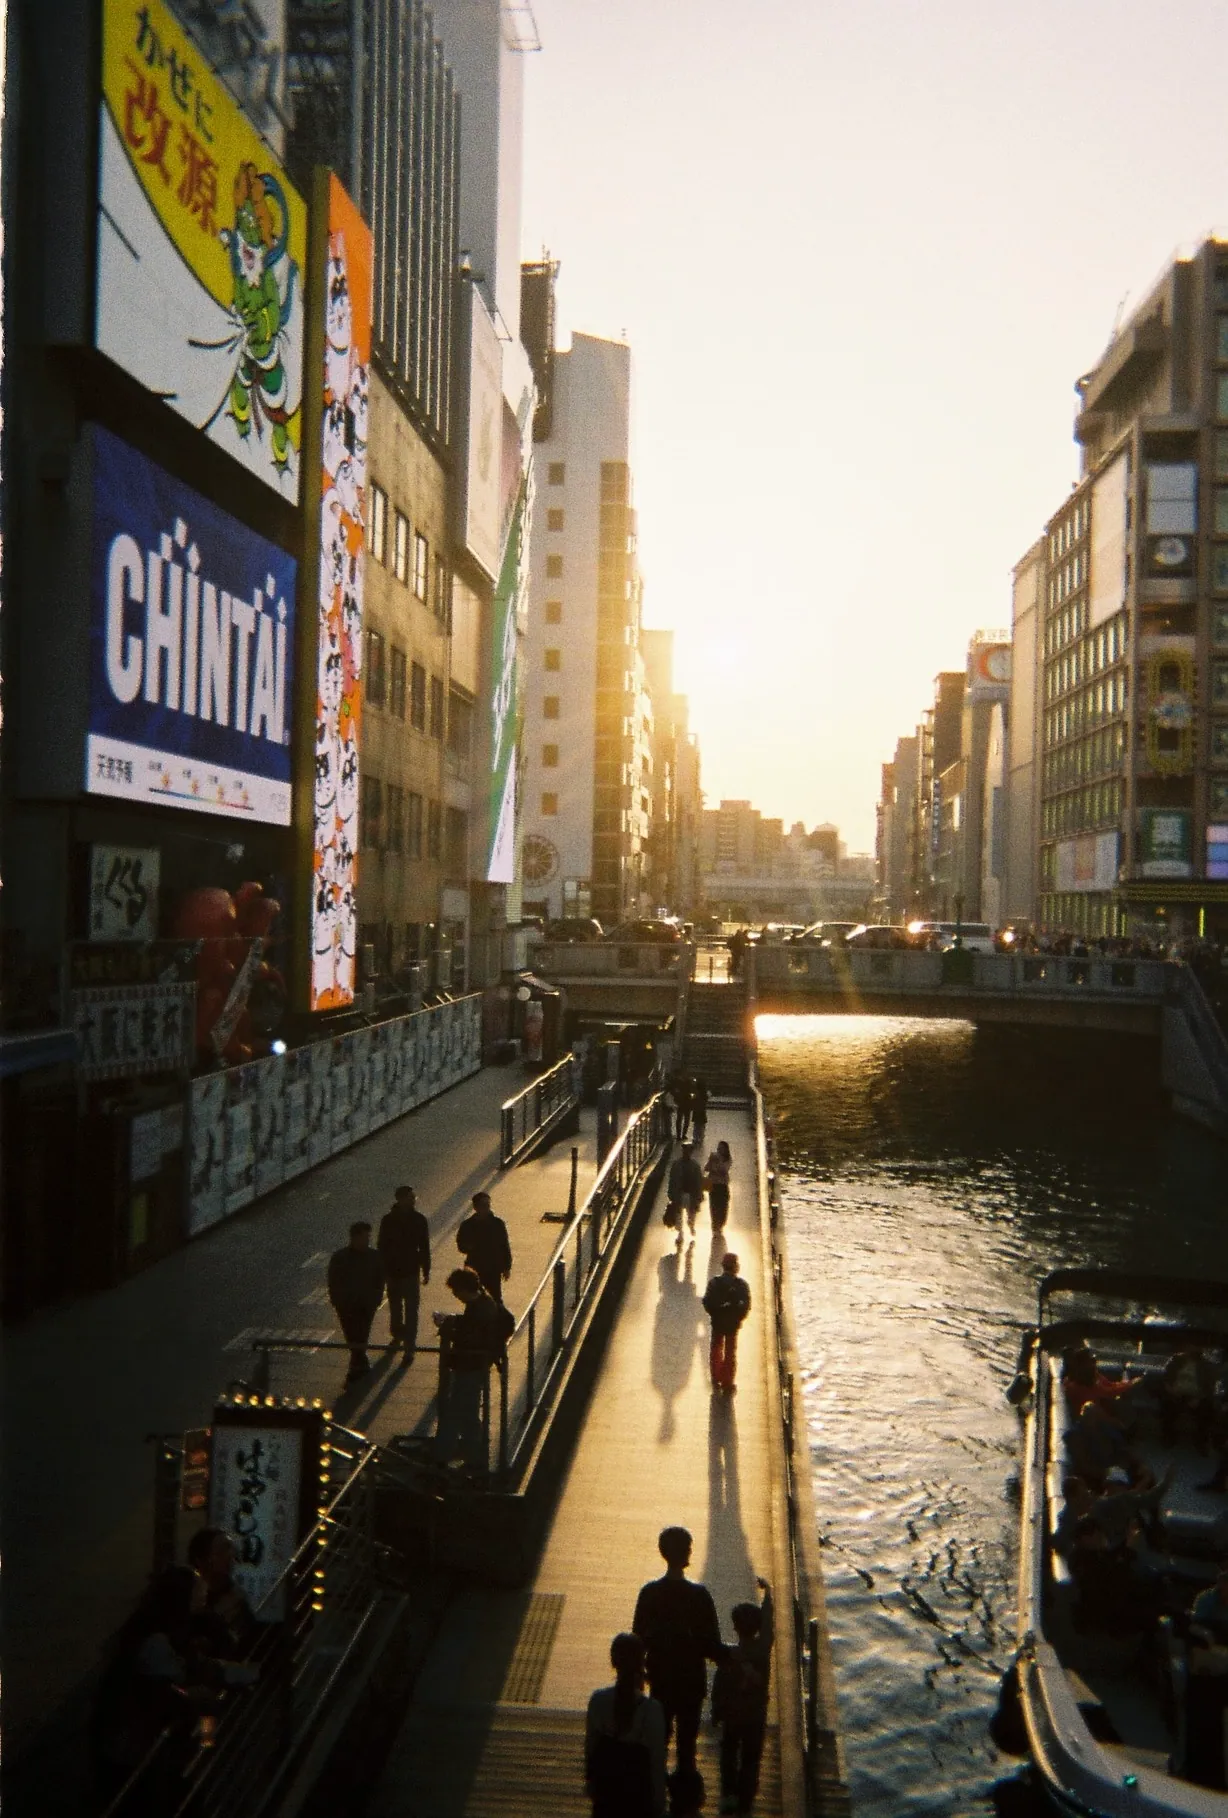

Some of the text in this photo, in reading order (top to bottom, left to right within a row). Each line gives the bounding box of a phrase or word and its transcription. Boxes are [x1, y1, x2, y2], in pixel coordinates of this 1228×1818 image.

[122, 55, 218, 238] 改源
[135, 6, 213, 143] かぜに
[106, 517, 288, 746] CHINTAI
